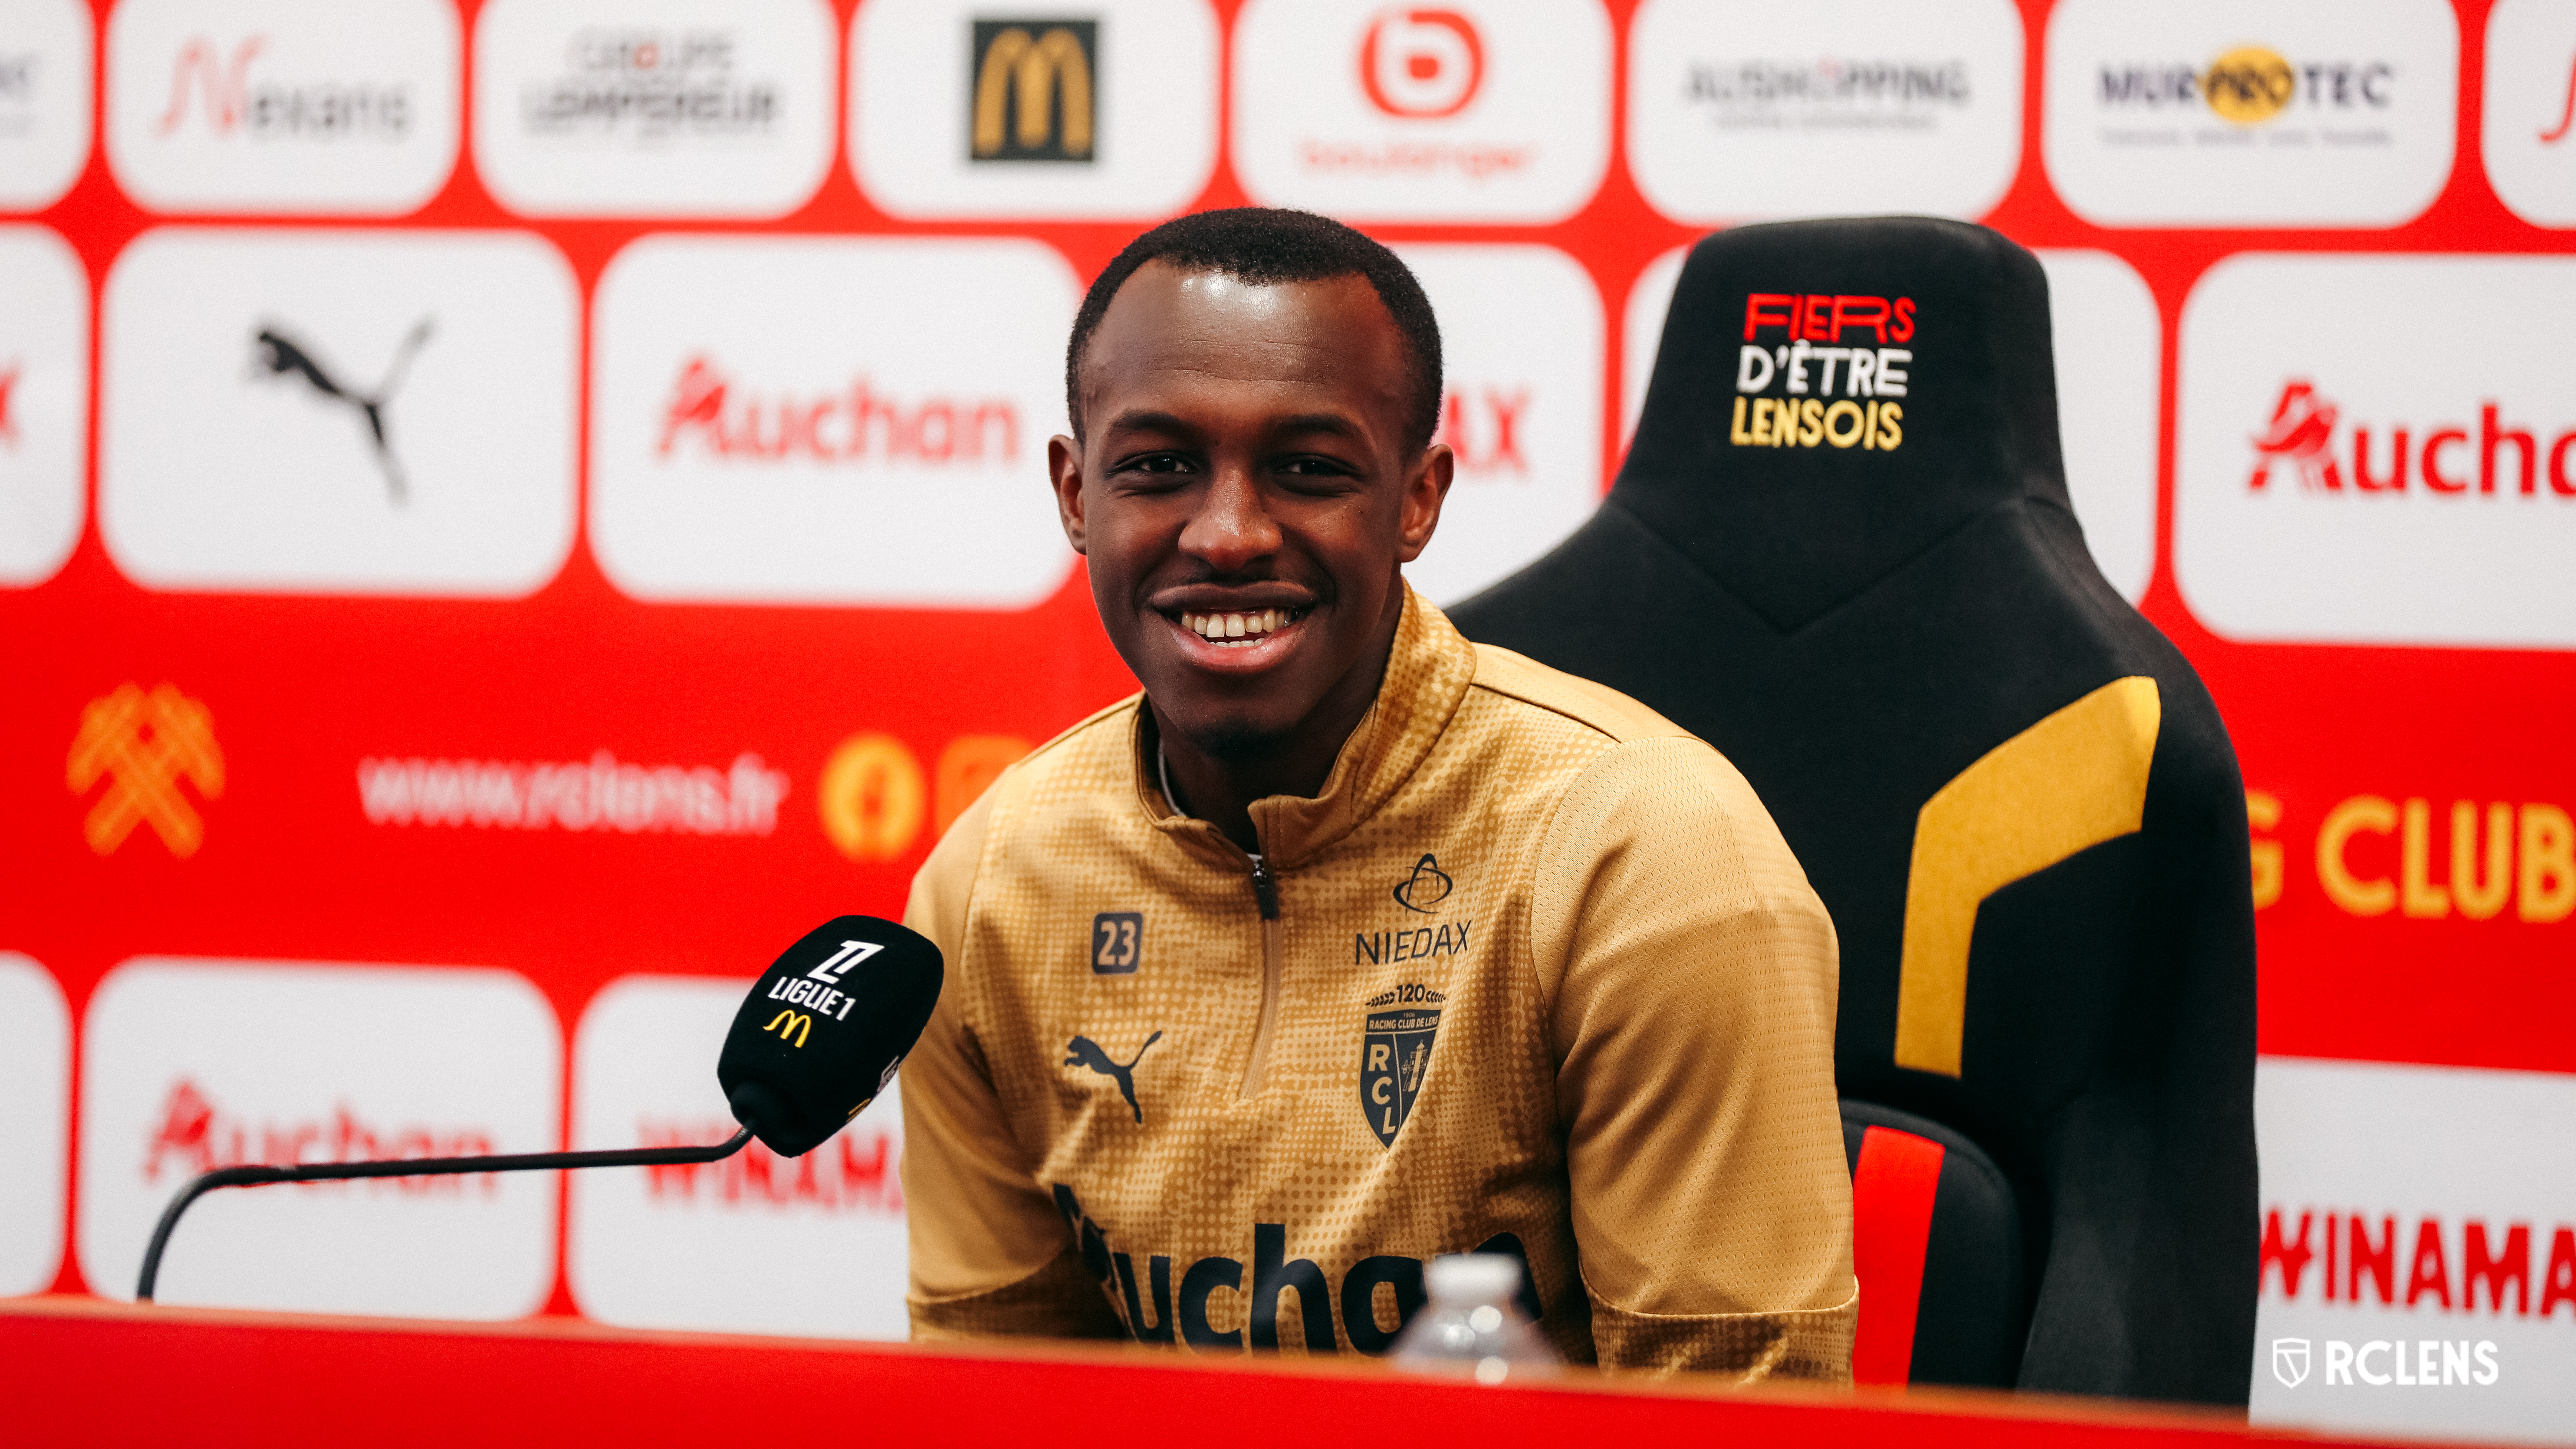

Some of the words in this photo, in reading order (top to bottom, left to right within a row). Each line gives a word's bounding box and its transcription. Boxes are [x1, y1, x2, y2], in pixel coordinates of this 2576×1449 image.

[2101, 57, 2390, 109] MURPROTEC
[1744, 294, 1916, 343] FIERS
[1737, 339, 1912, 397] D'ÊTRE
[656, 354, 1020, 465] Auchan
[1730, 396, 1903, 452] LENSOIS
[358, 751, 789, 834] www.rclens.fr
[2315, 795, 2576, 923] CLUB
[1097, 920, 1136, 966] 23
[1356, 920, 1471, 965] NIEDAX
[1397, 984, 1425, 1003] 120
[1369, 1020, 1396, 1030] RACING
[1398, 1019, 1416, 1029] CLUB
[1416, 1018, 1425, 1028] DE
[1425, 1015, 1439, 1027] LENS
